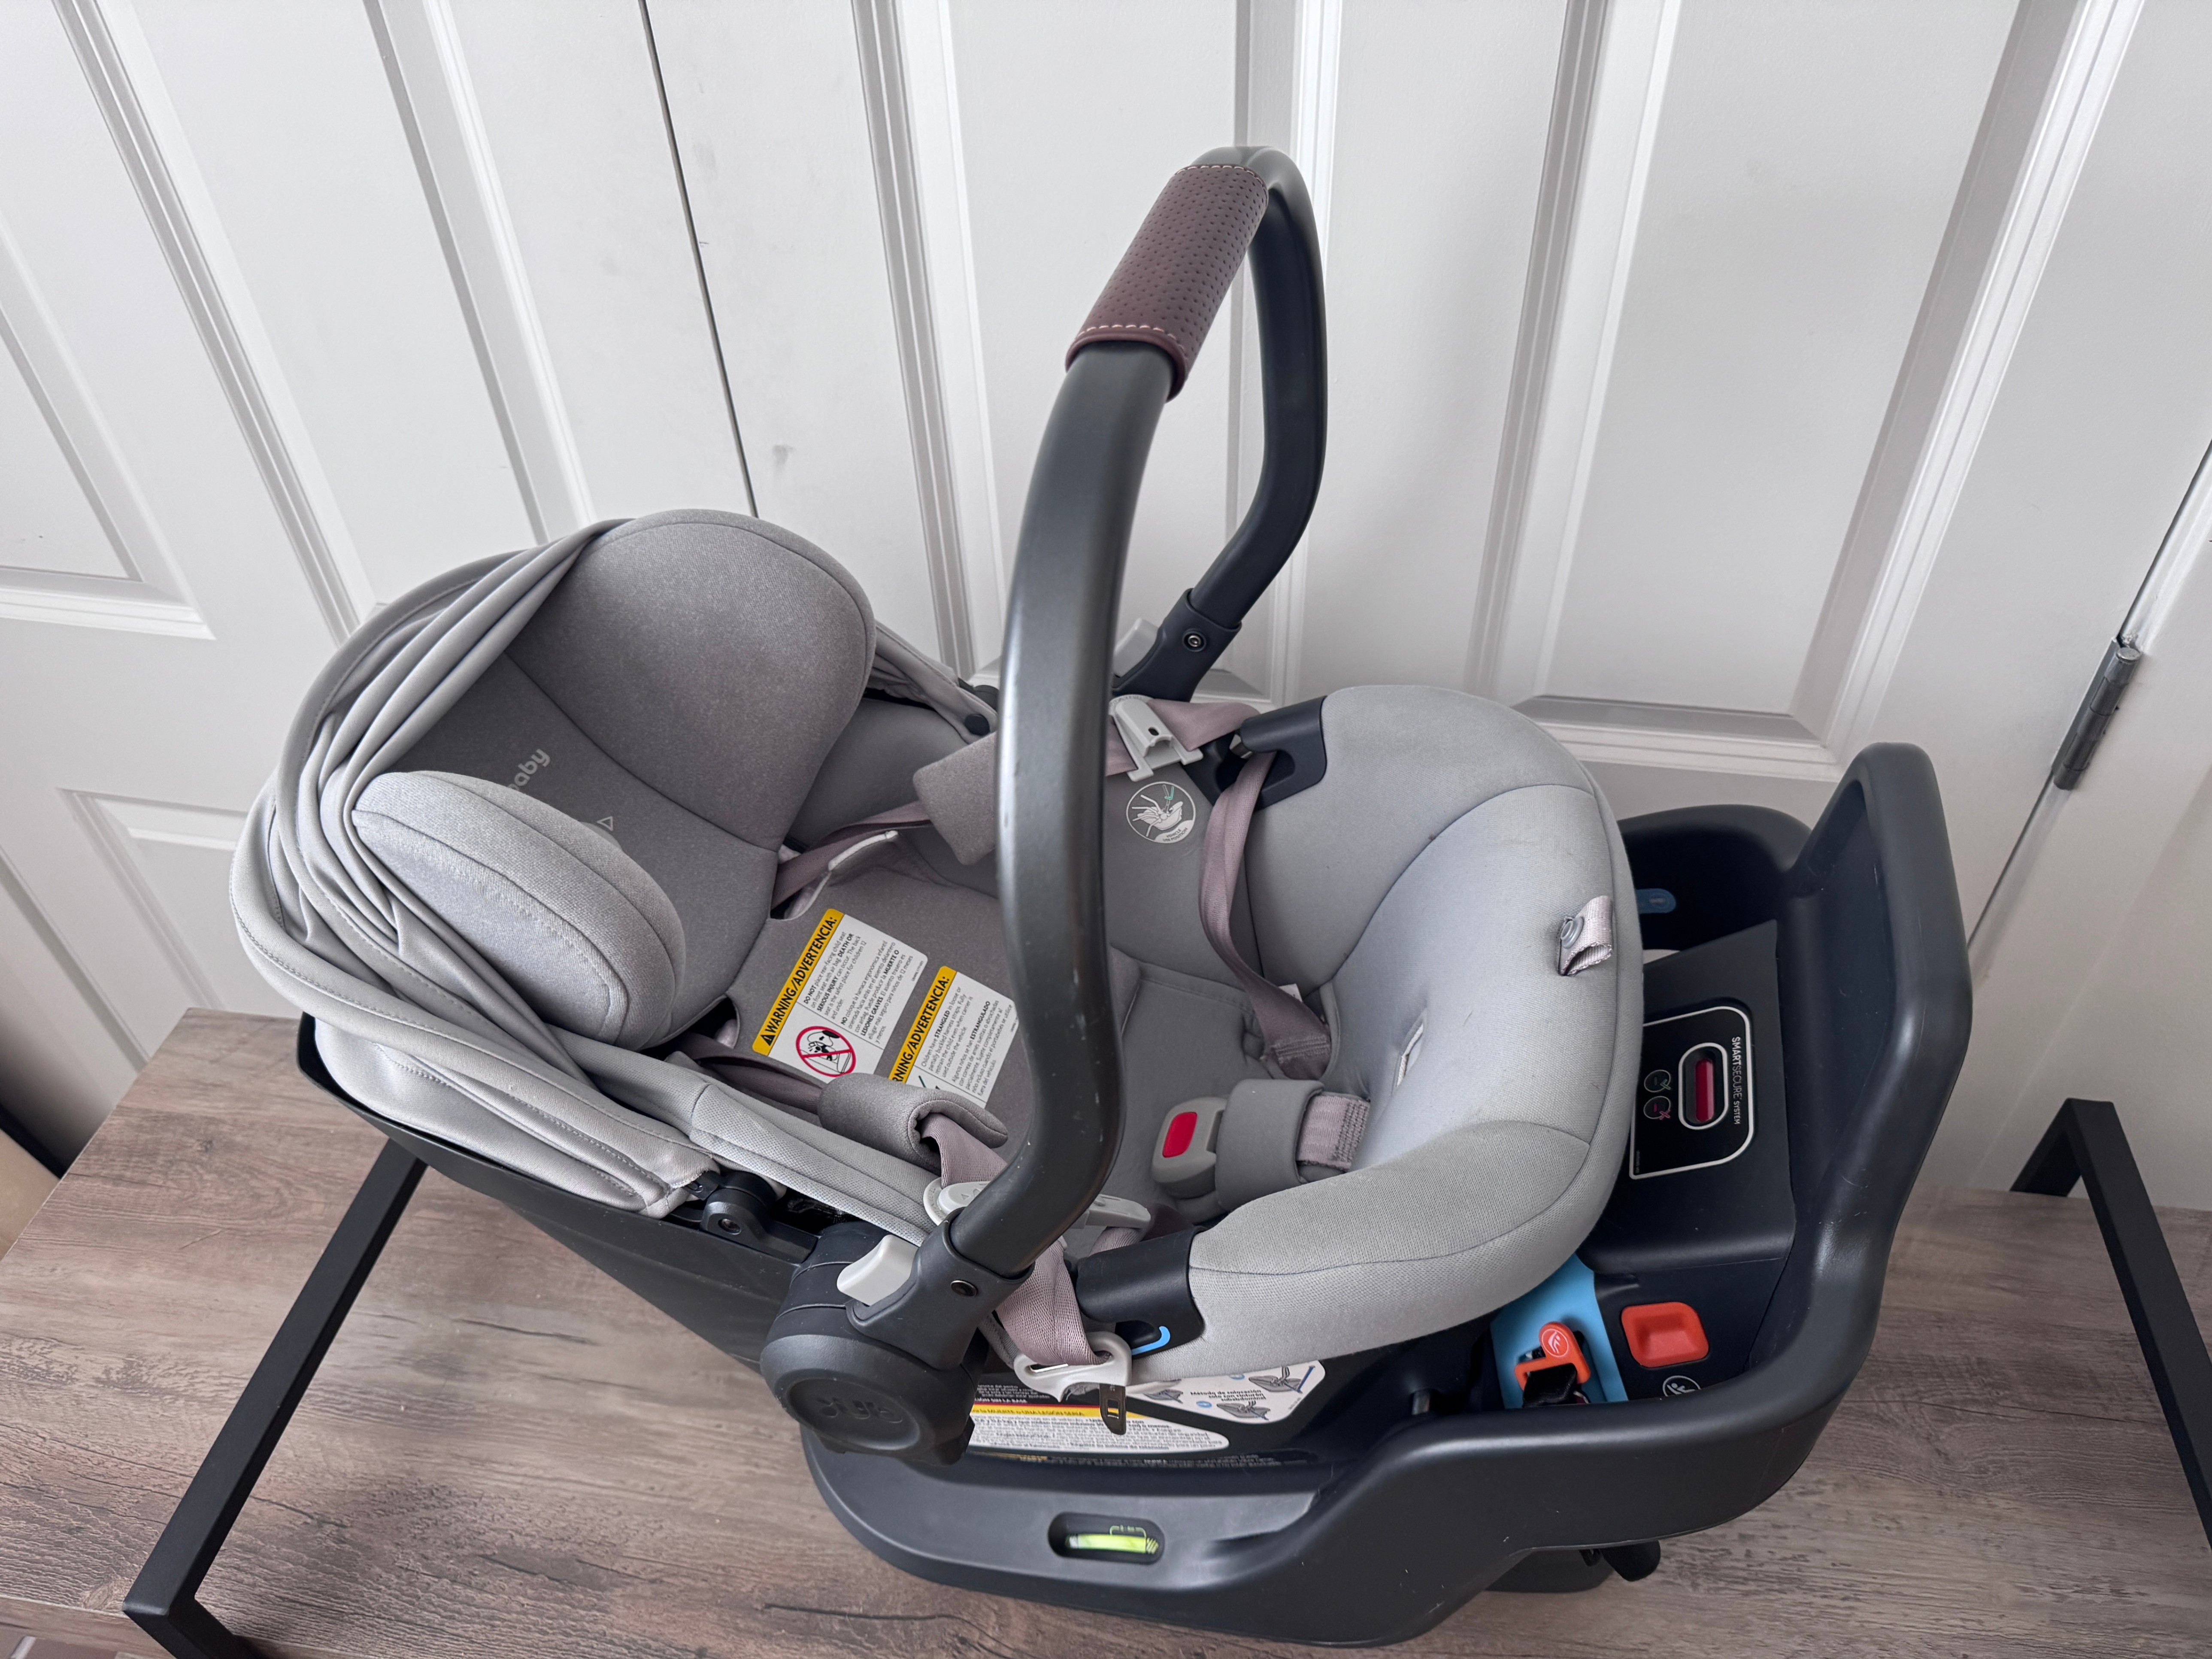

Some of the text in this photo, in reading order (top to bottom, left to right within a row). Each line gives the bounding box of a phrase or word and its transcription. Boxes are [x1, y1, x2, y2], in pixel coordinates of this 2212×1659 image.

[1166, 828, 1181, 838] VEHICLE
[837, 940, 849, 957] DEATH
[765, 917, 837, 1033] WARNING/ADVERTENCIA:
[883, 955, 896, 974] MUERTE
[808, 985, 816, 996] NOT
[817, 992, 829, 1011] SERIOUS
[827, 976, 838, 992] INJURY
[861, 1015, 874, 1035] LESIONES
[892, 977, 949, 1082] RNING/ADVERTENCIA:
[934, 1010, 949, 1037] STRANGLED
[970, 1001, 990, 1039] ESTRANGULADO
